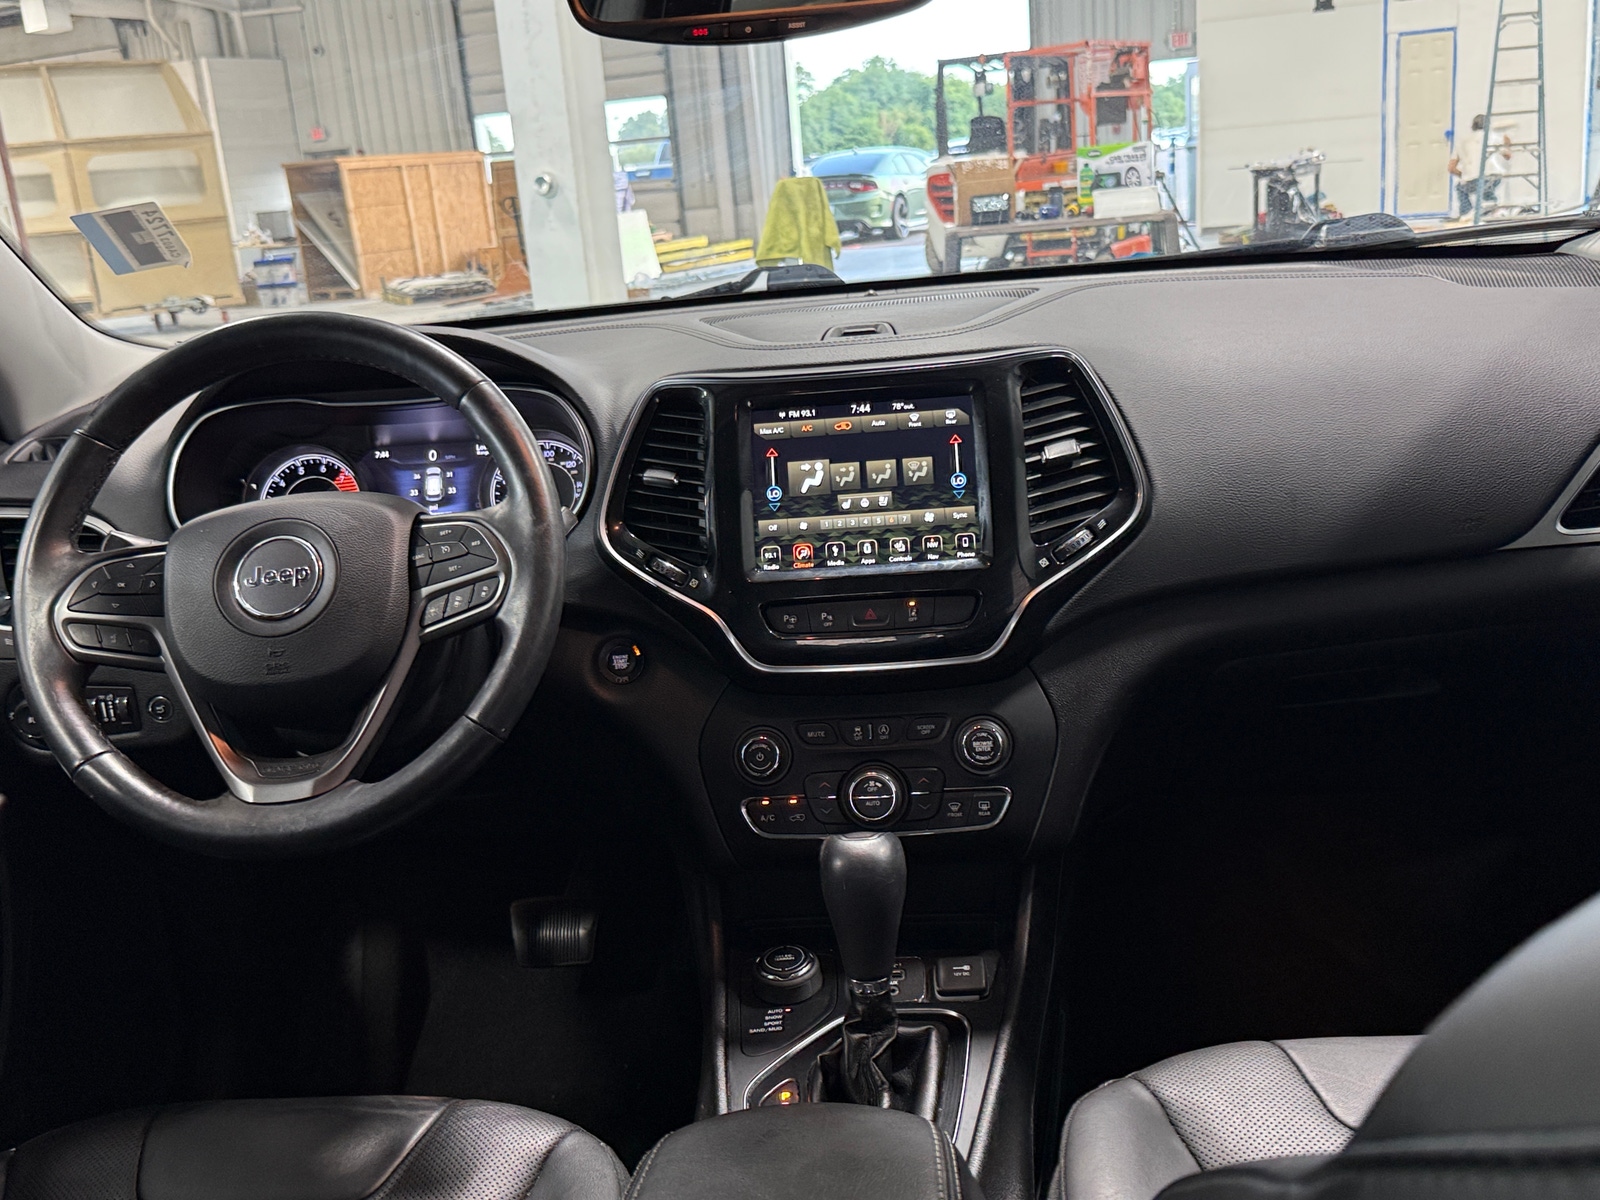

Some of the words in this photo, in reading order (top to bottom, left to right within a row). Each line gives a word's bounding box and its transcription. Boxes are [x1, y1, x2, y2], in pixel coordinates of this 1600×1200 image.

[693, 28, 709, 36] SOS
[801, 409, 816, 417] 93.1
[851, 404, 871, 414] 7:44
[429, 450, 437, 461] 0
[298, 467, 305, 475] 5
[953, 477, 963, 485] LO
[768, 490, 779, 498] LO
[244, 566, 311, 588] Jeep
[749, 1026, 783, 1034] SAND/MUD
